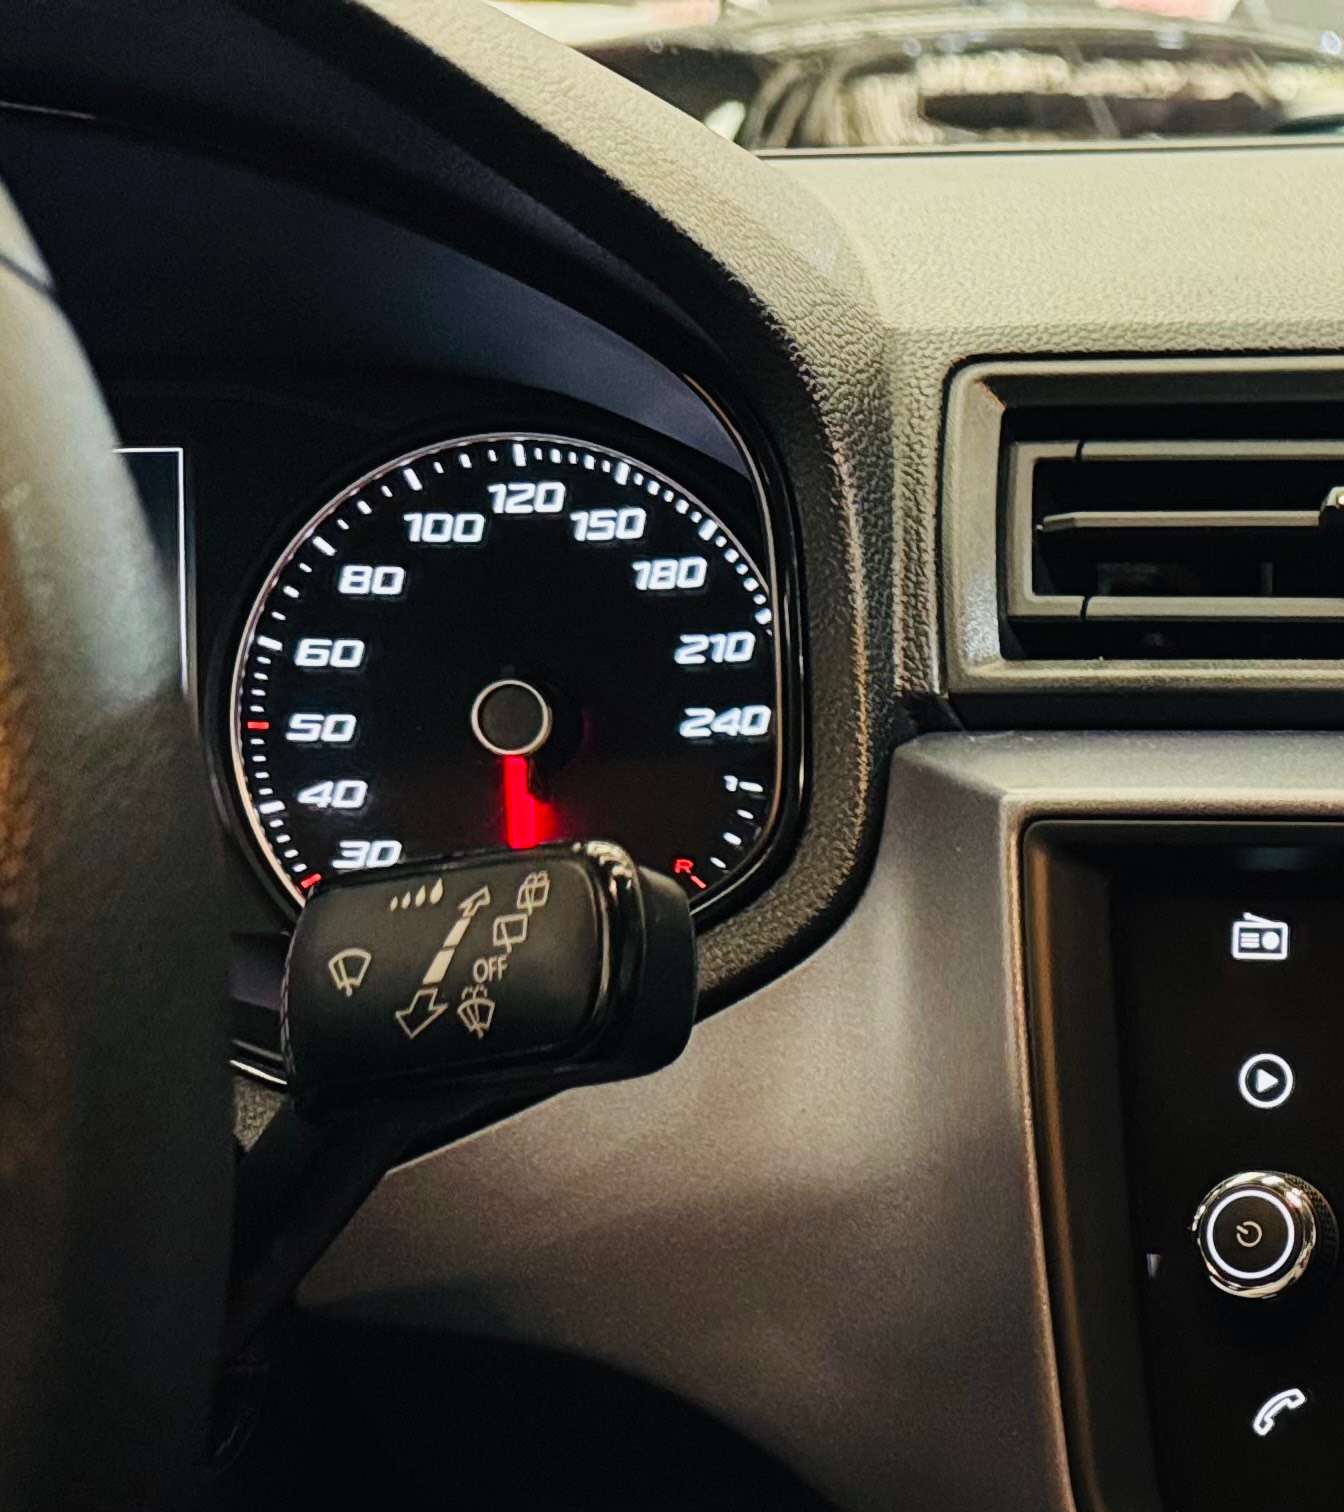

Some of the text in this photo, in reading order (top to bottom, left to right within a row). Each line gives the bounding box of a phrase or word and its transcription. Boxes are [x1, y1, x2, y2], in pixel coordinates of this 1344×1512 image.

[488, 482, 565, 515] 120
[404, 512, 485, 543] 100
[571, 507, 646, 541] 150
[338, 565, 405, 595] 80
[633, 556, 707, 591] 180
[295, 638, 365, 668] 60
[674, 631, 756, 664] 210
[286, 713, 357, 742] 50
[680, 705, 772, 738] 240
[298, 779, 368, 809] 40
[332, 840, 402, 869] 30
[473, 953, 508, 983] OFF
